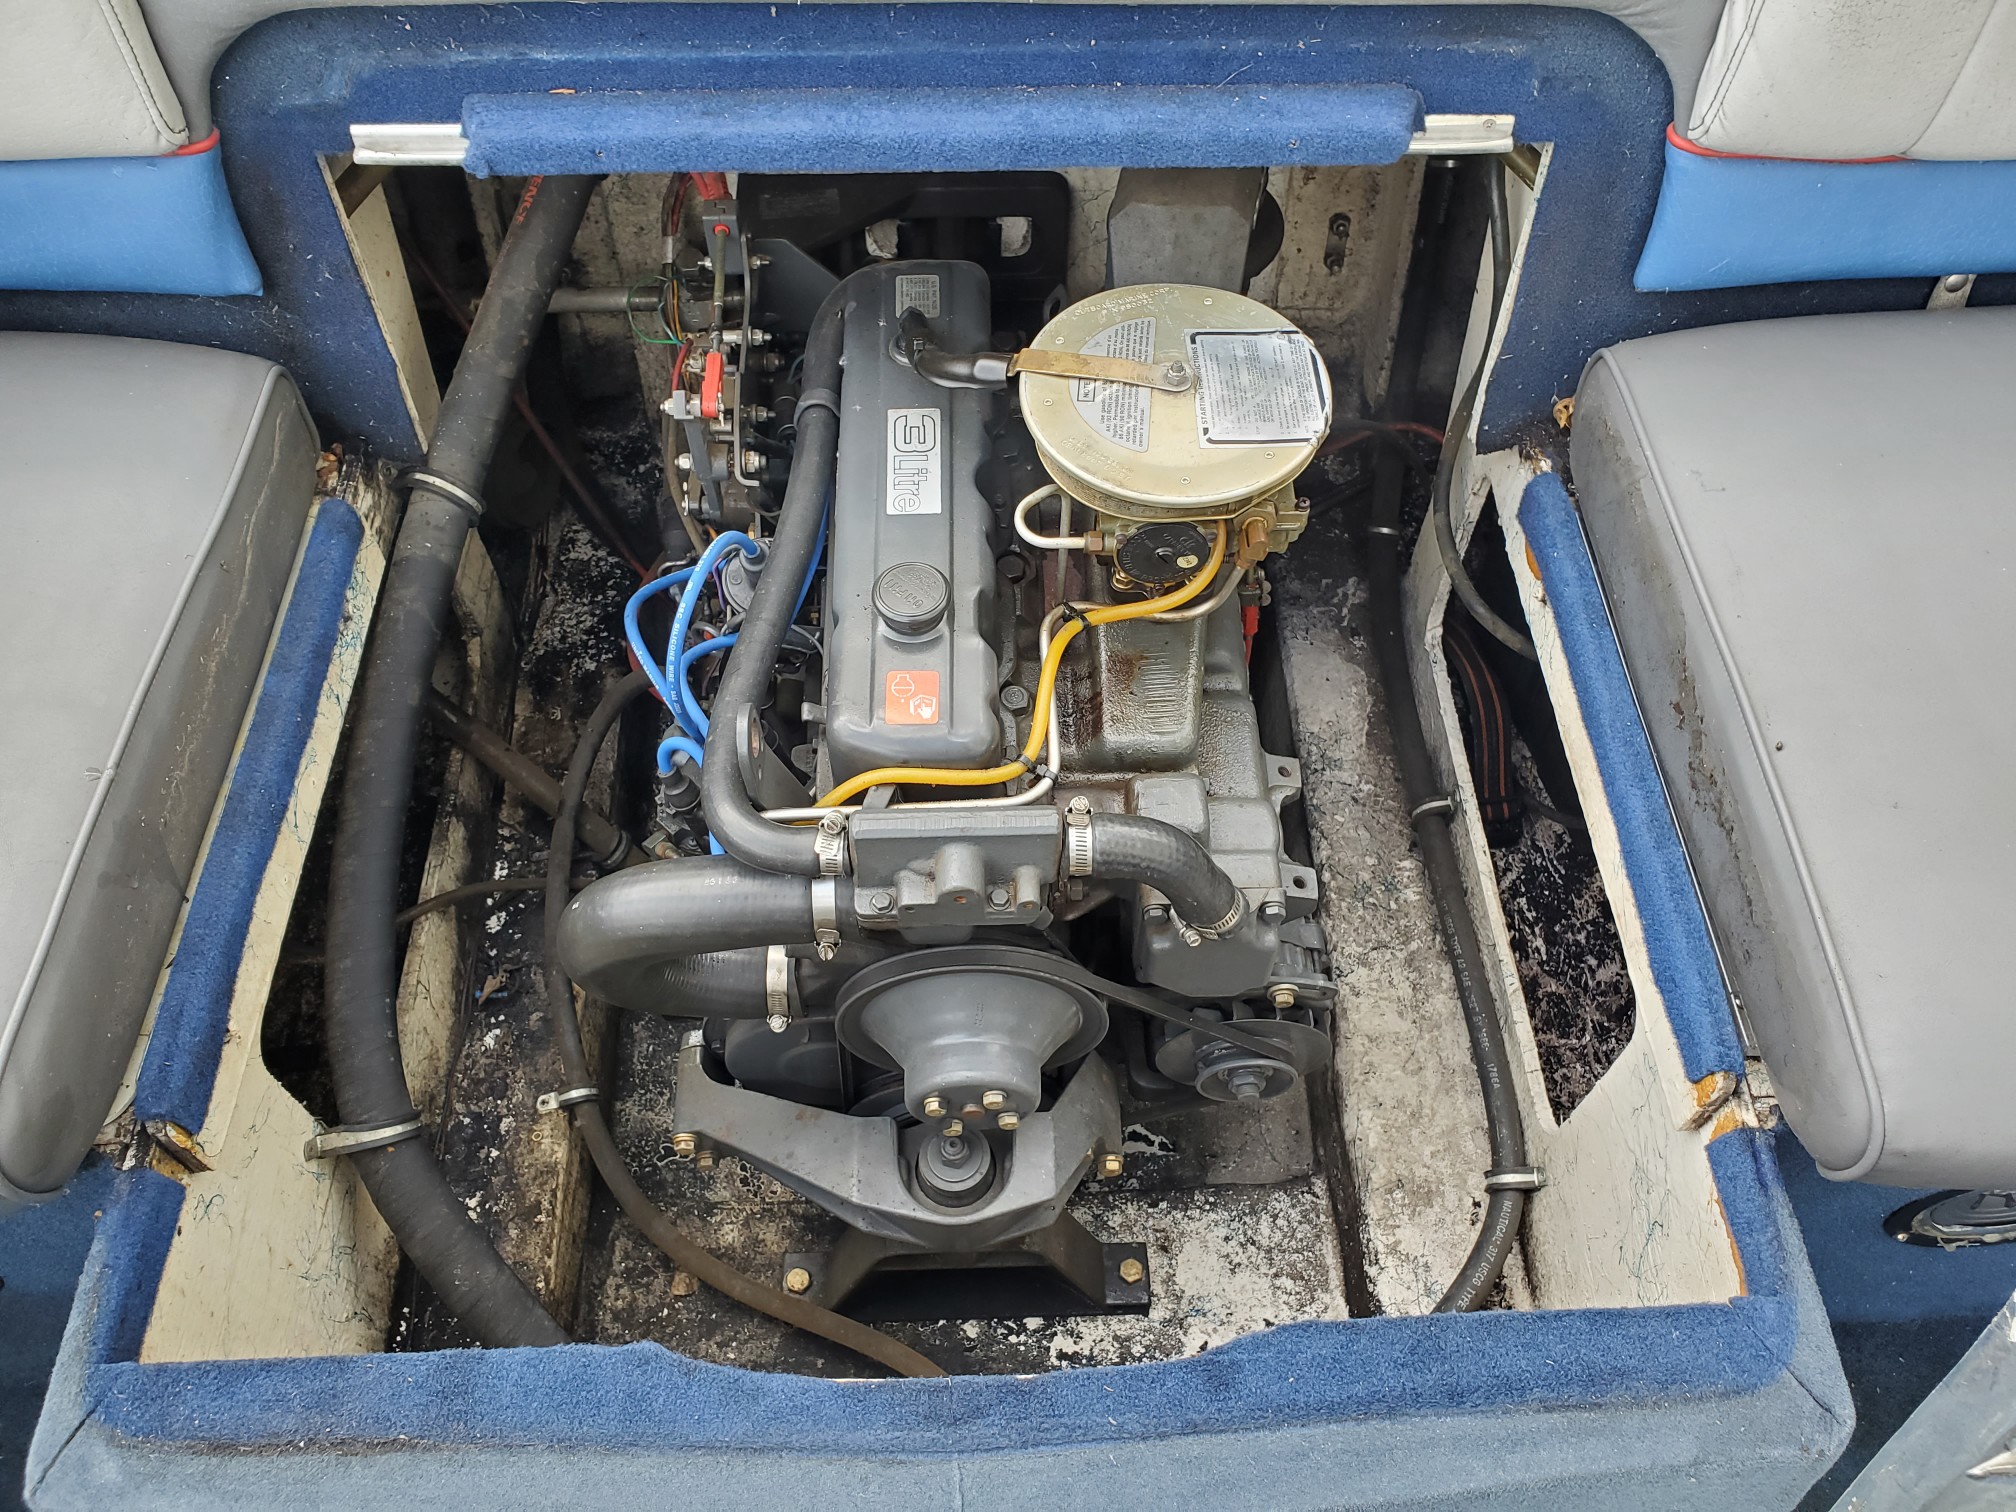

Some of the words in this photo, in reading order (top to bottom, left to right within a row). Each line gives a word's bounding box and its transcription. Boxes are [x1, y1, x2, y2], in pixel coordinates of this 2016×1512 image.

[515, 174, 544, 225] ENCE
[1083, 381, 1091, 399] NOTE
[1198, 391, 1208, 425] STARTING
[893, 415, 936, 453] 3
[893, 454, 928, 513] Litre
[669, 623, 681, 662] SILICONE
[1451, 935, 1462, 956] TYPE
[1485, 1245, 1498, 1262] 317
[1472, 1262, 1492, 1287] USCG
[1457, 1287, 1477, 1310] TYPE
